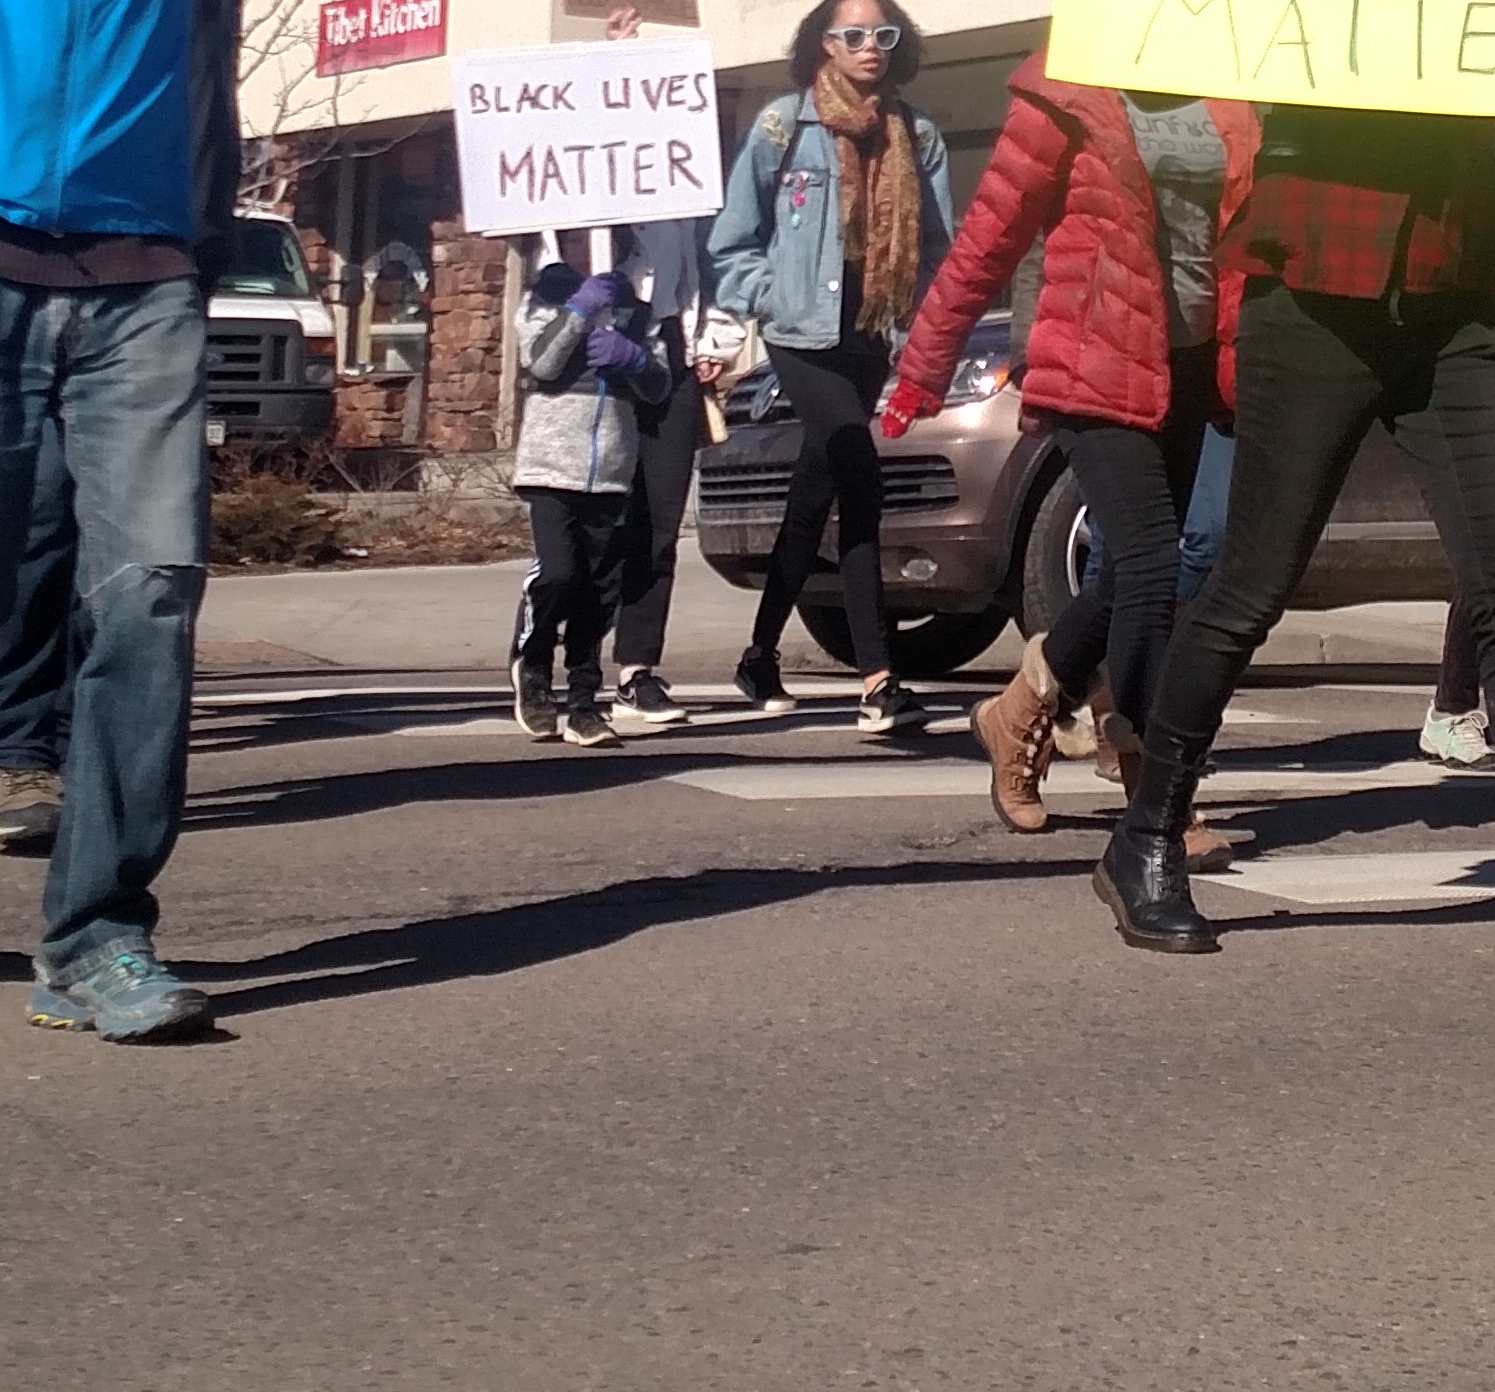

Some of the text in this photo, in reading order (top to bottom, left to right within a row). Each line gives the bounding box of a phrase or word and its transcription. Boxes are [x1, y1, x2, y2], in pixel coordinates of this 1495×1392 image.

[325, 6, 367, 46] Tibet
[469, 72, 709, 114] BLACK LIVES
[498, 139, 704, 204] MATTER
